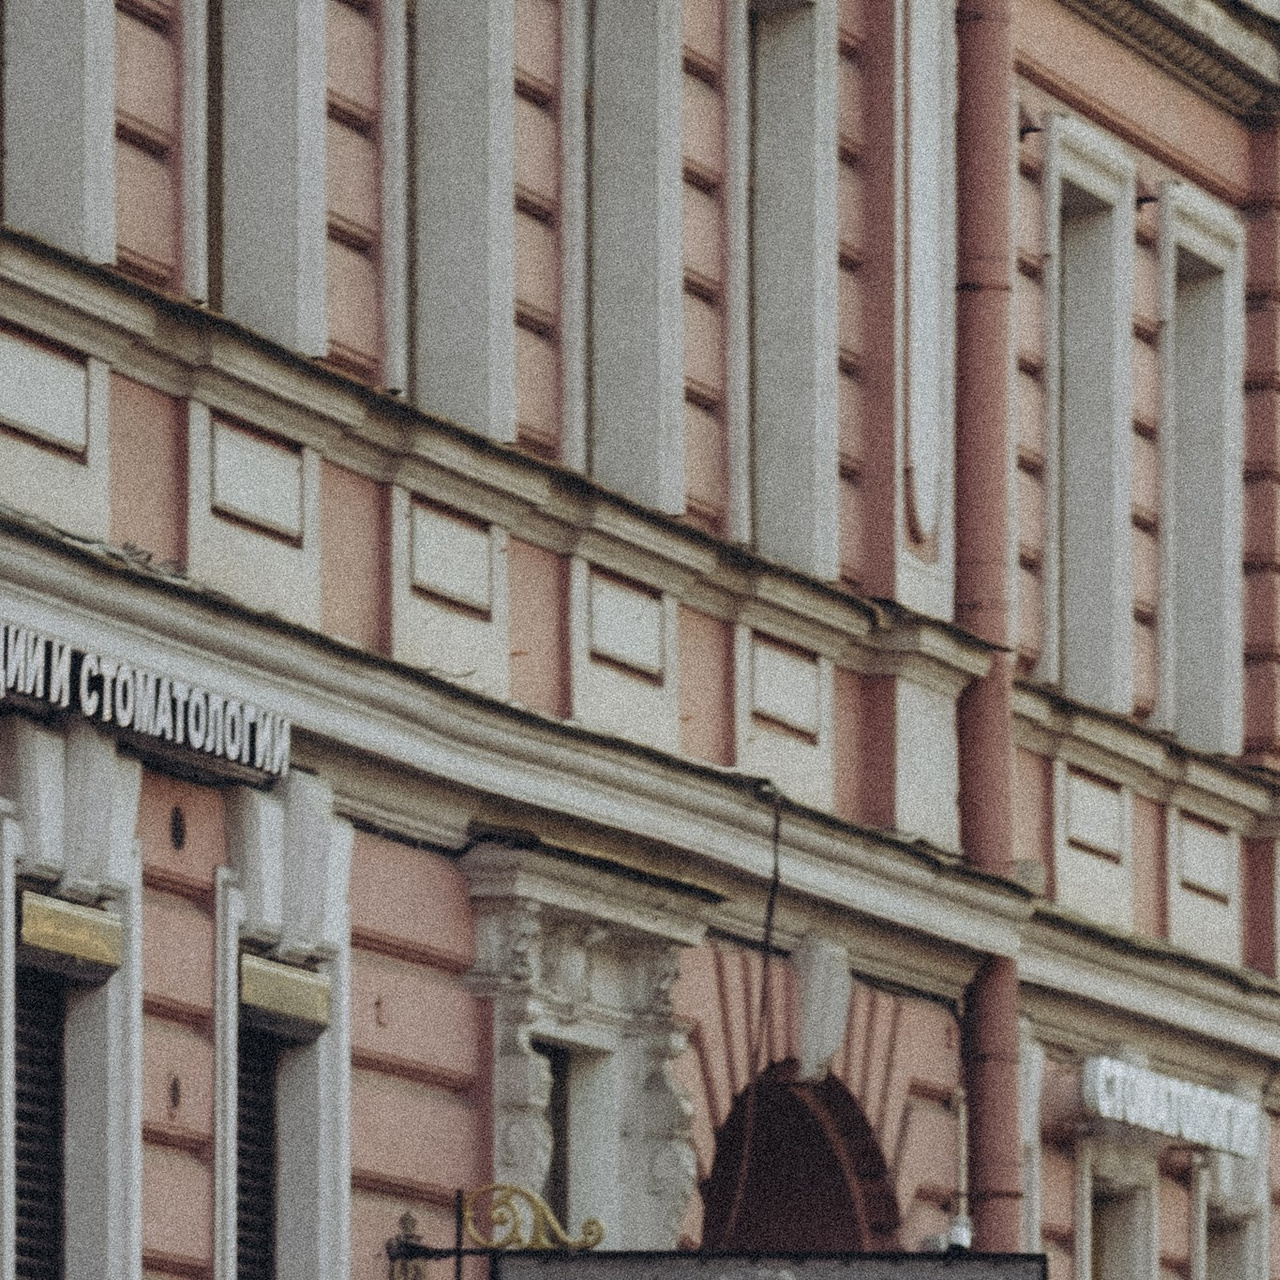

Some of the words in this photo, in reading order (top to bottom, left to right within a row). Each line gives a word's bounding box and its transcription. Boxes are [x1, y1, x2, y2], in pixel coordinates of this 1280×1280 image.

[0, 621, 45, 699] ИИ
[50, 638, 71, 707] И
[79, 653, 291, 776] СТОМАТОЛОГИИ
